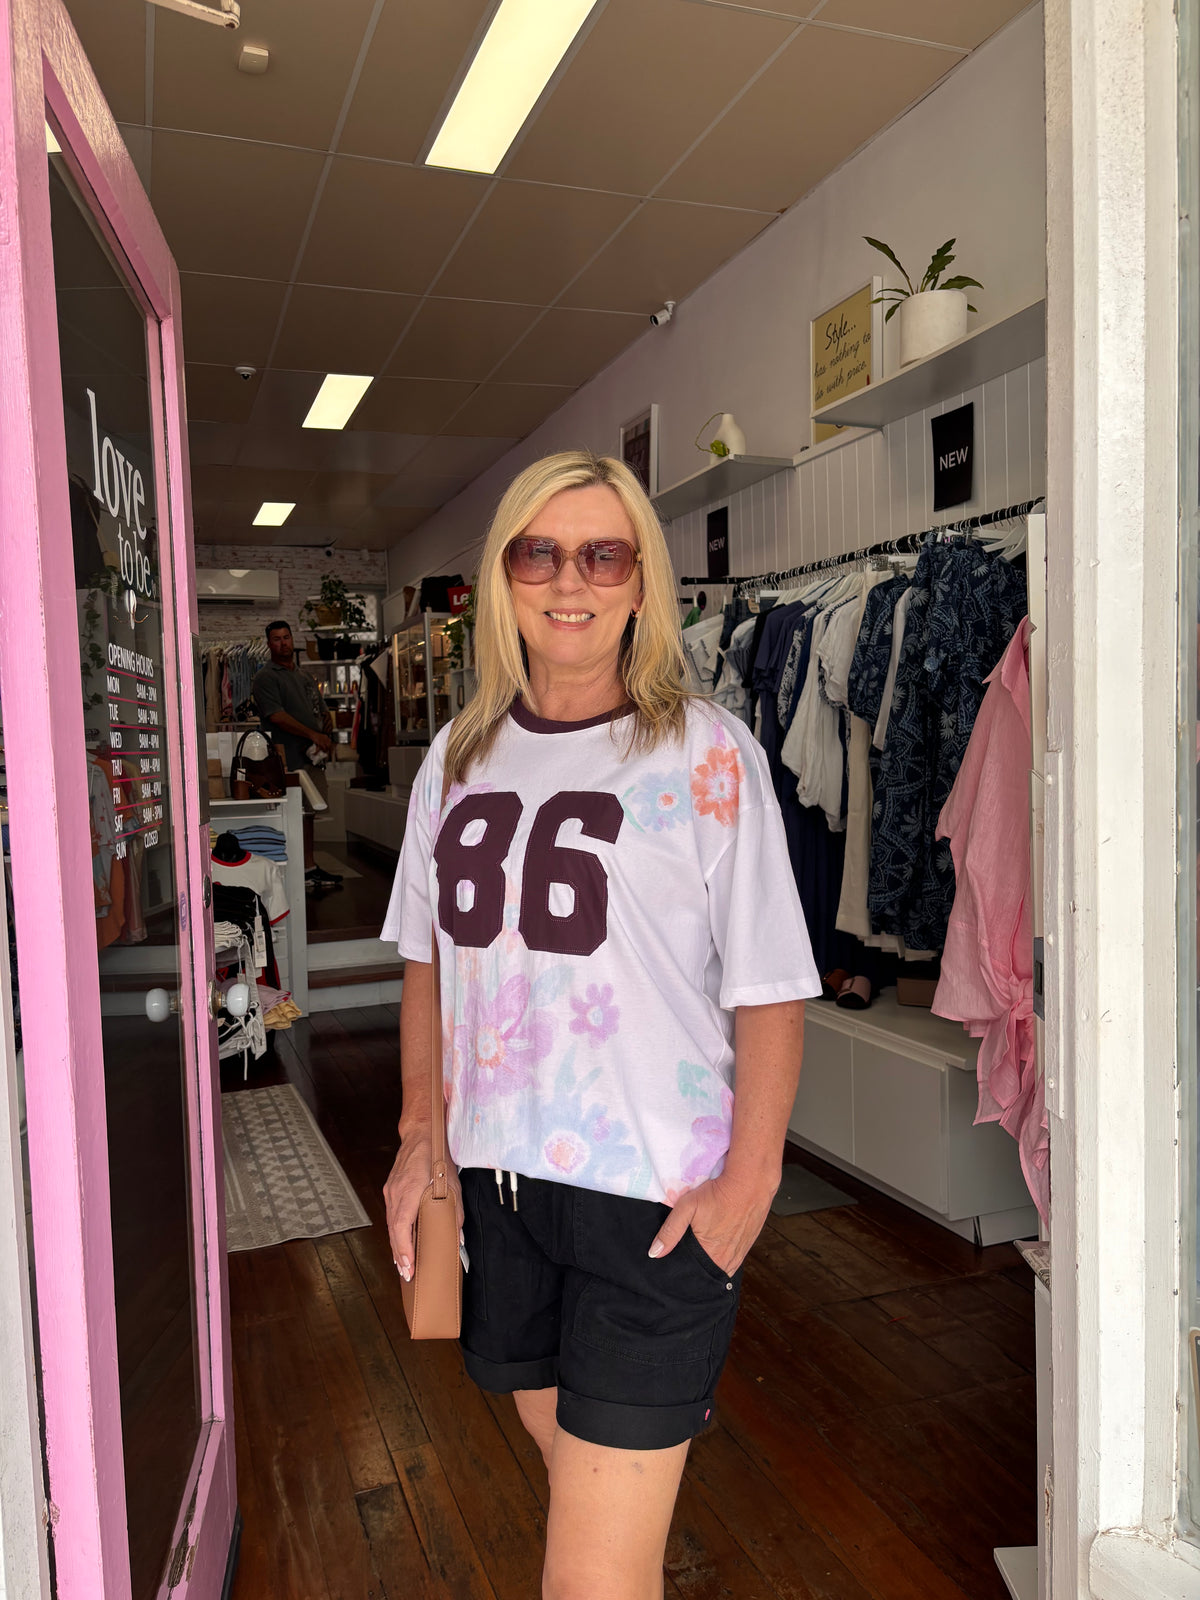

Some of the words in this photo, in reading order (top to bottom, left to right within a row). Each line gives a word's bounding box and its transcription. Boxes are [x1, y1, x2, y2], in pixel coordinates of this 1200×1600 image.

[815, 362, 826, 378] has
[829, 341, 860, 368] nothing
[863, 331, 871, 345] to
[815, 388, 824, 401] do
[826, 368, 844, 394] with
[87, 388, 147, 540] love
[939, 446, 969, 472] NEW
[708, 537, 726, 553] NEW
[118, 523, 132, 586] to
[133, 531, 151, 598] be
[108, 643, 135, 672] OPENING
[135, 652, 154, 678] HOURS
[106, 675, 120, 694] MON
[108, 703, 119, 721] TUE
[110, 731, 123, 748] WED
[111, 760, 123, 776] THU
[112, 787, 121, 805] FRI
[114, 814, 123, 832] SAT
[115, 841, 127, 860] SUN
[144, 830, 159, 848] CLOSED
[433, 790, 625, 956] 86
